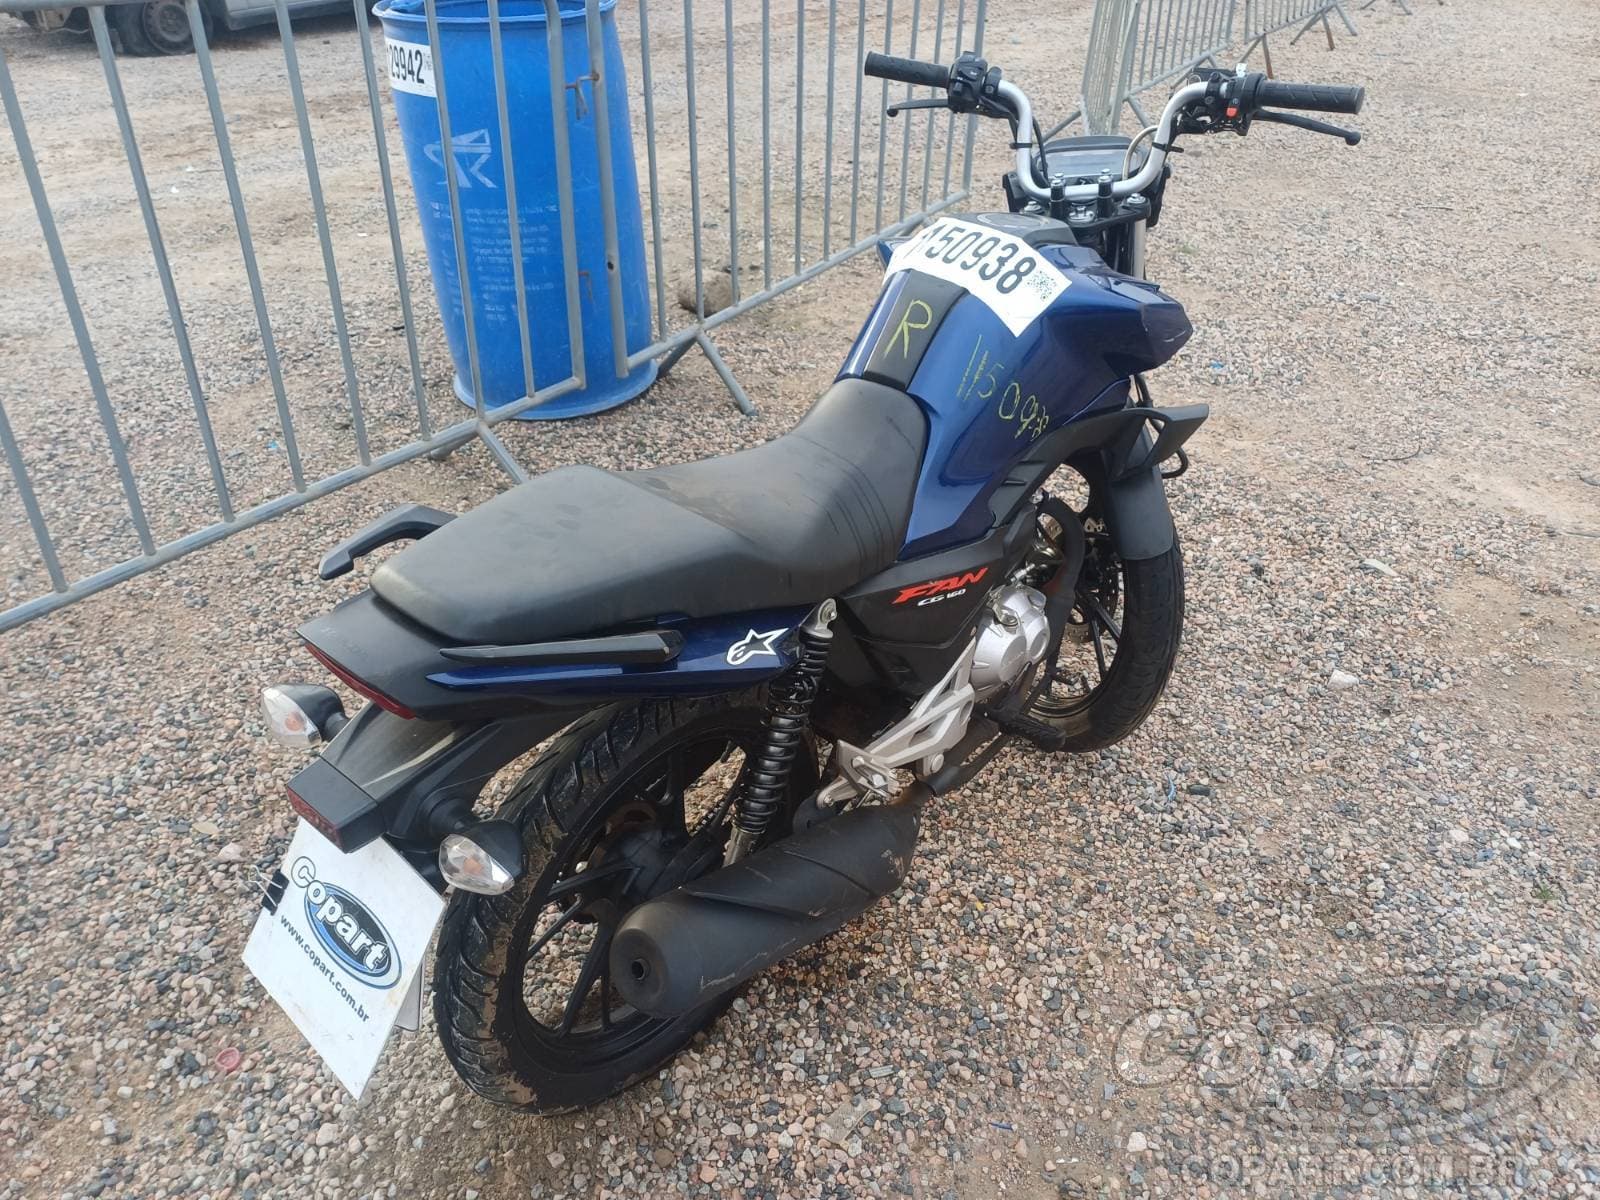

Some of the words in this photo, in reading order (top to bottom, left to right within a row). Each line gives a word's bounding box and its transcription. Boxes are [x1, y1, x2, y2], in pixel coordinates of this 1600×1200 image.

[386, 44, 425, 84] 29942
[884, 299, 933, 359] R
[891, 567, 988, 604] FAN
[917, 594, 945, 606] CG
[946, 588, 966, 599] 160
[290, 855, 390, 972] Copart
[280, 913, 370, 1023] www.copart.com.br
